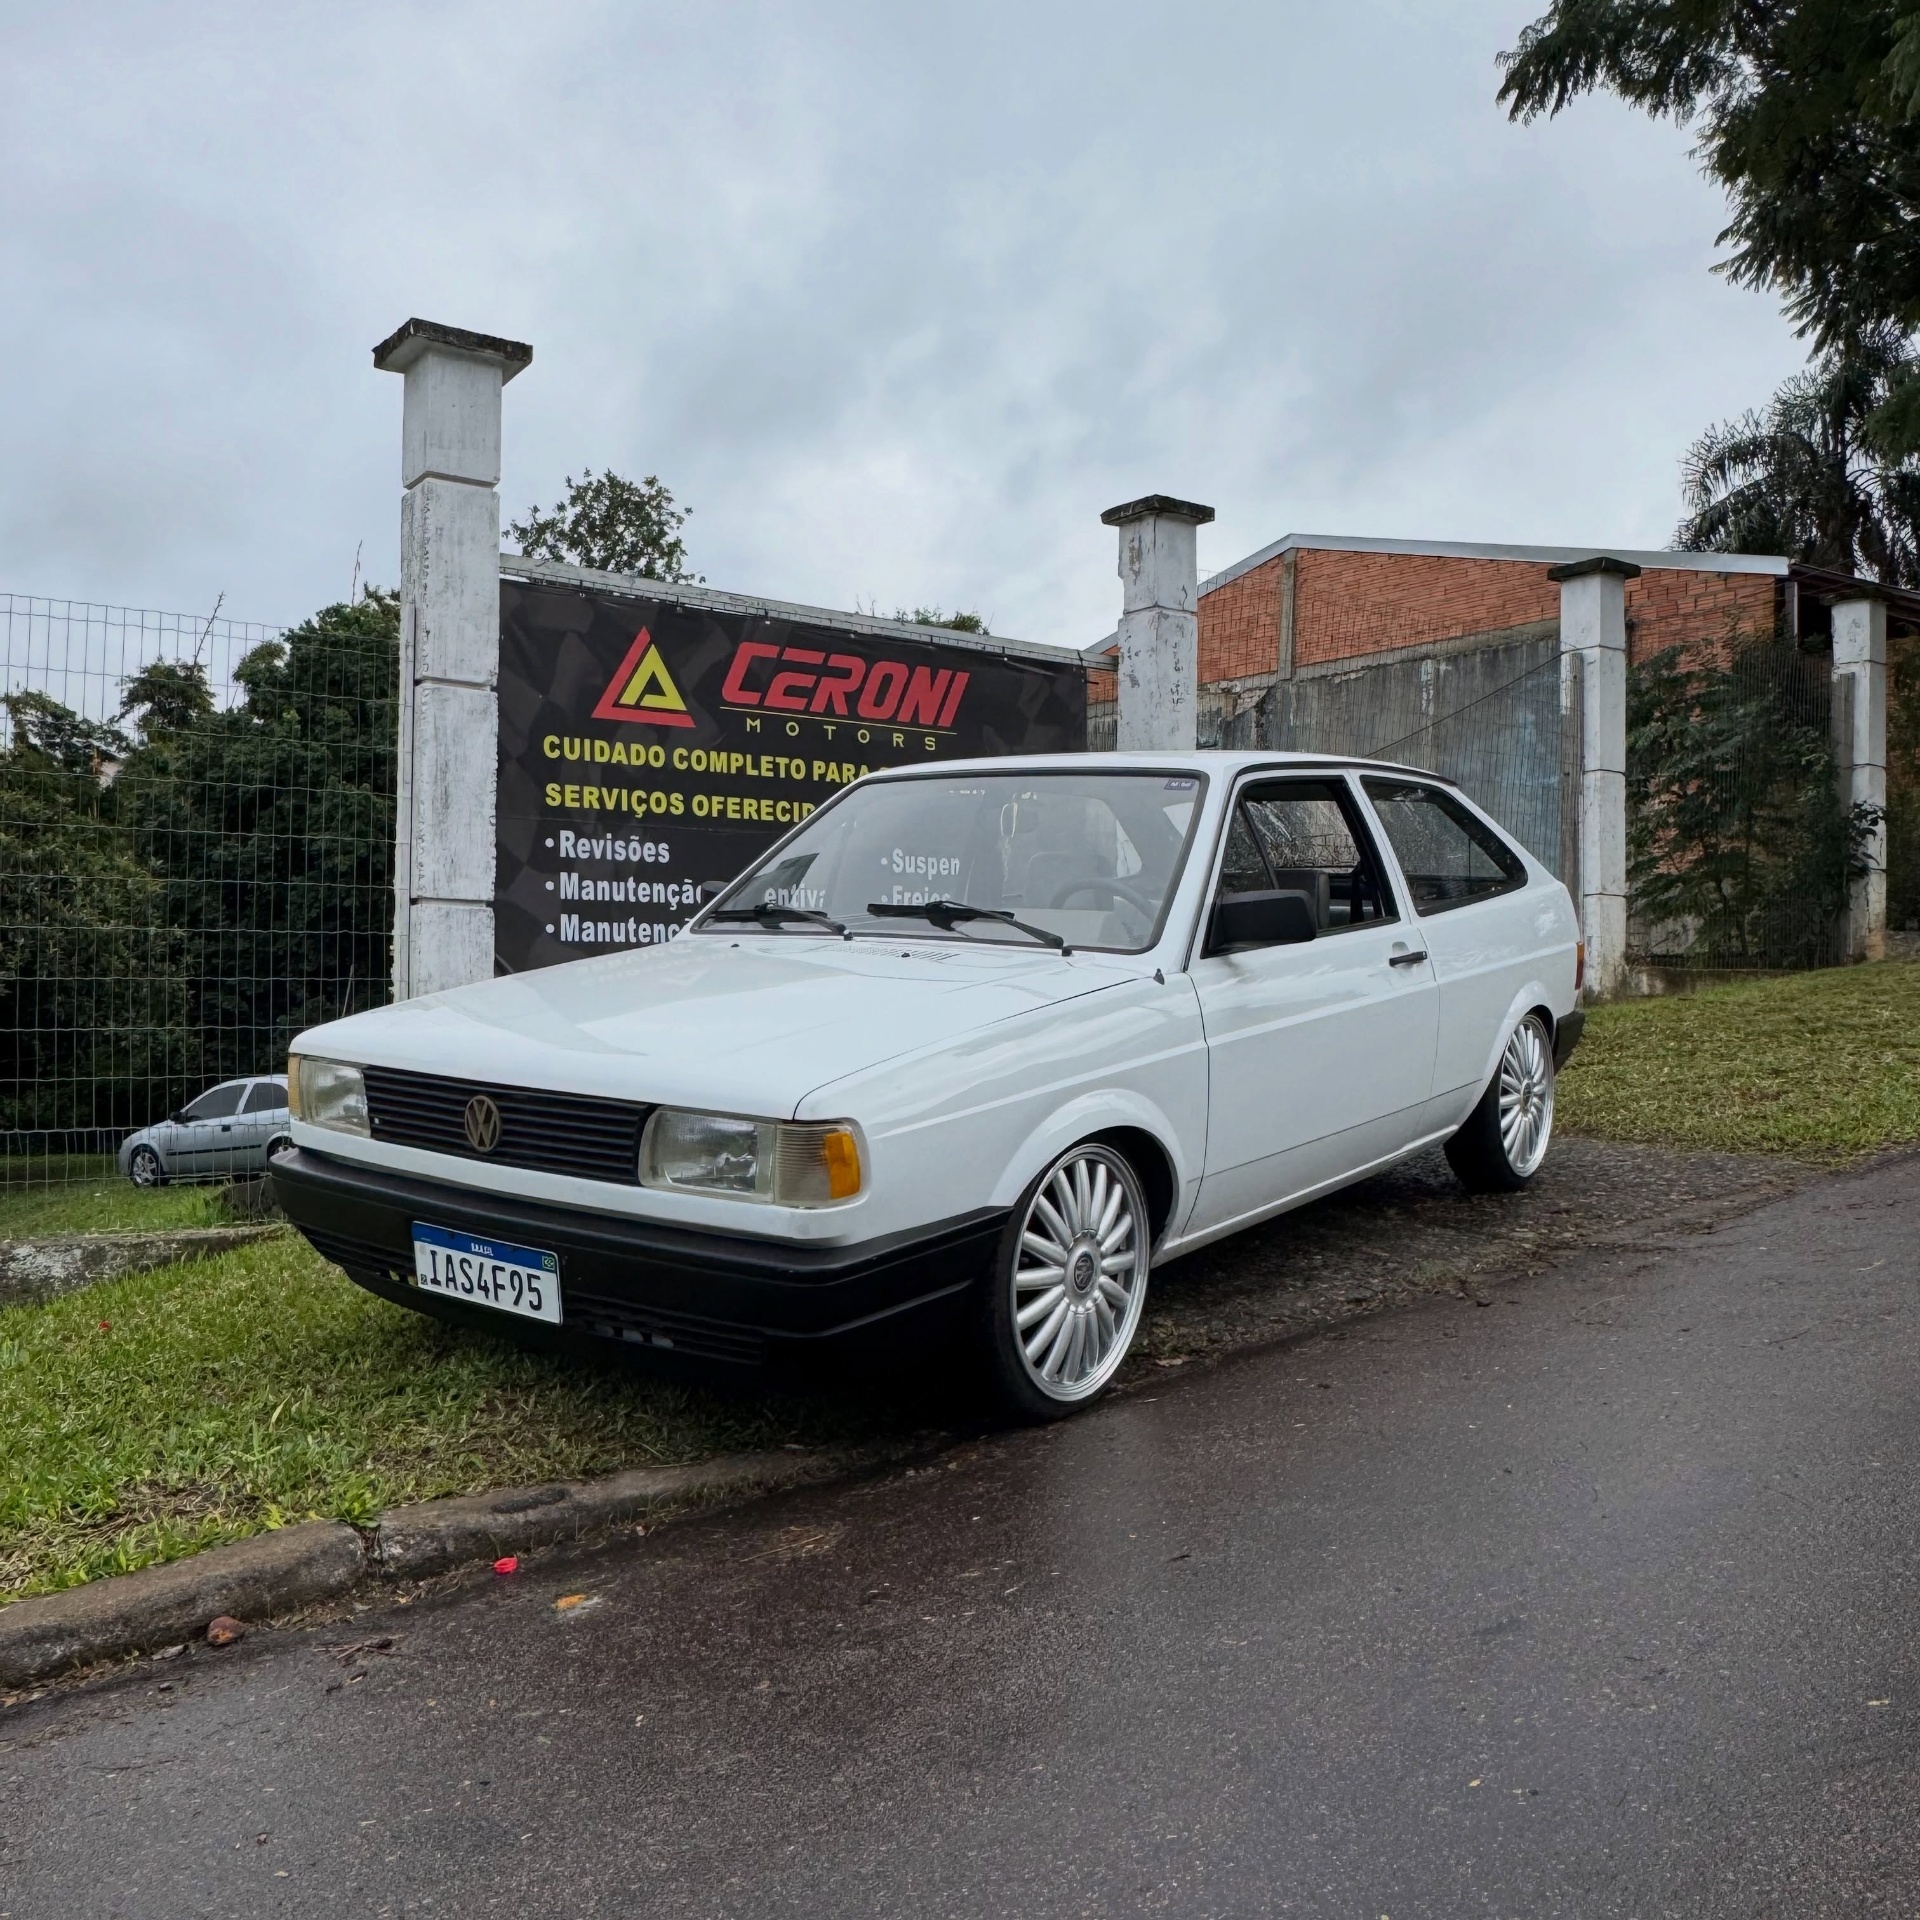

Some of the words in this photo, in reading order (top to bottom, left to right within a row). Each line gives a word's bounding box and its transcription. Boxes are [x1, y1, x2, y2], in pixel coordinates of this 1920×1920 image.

[721, 641, 971, 728] CERONI
[746, 717, 936, 751] MOTORS
[543, 735, 666, 768] CUIDADO
[672, 747, 806, 780] COMPLETO
[545, 783, 685, 818] SERVIÇOS
[559, 830, 670, 863] Revisões
[892, 848, 960, 880] Suspen
[560, 914, 692, 943] Manuten
[430, 1249, 542, 1311] IAS4F95
